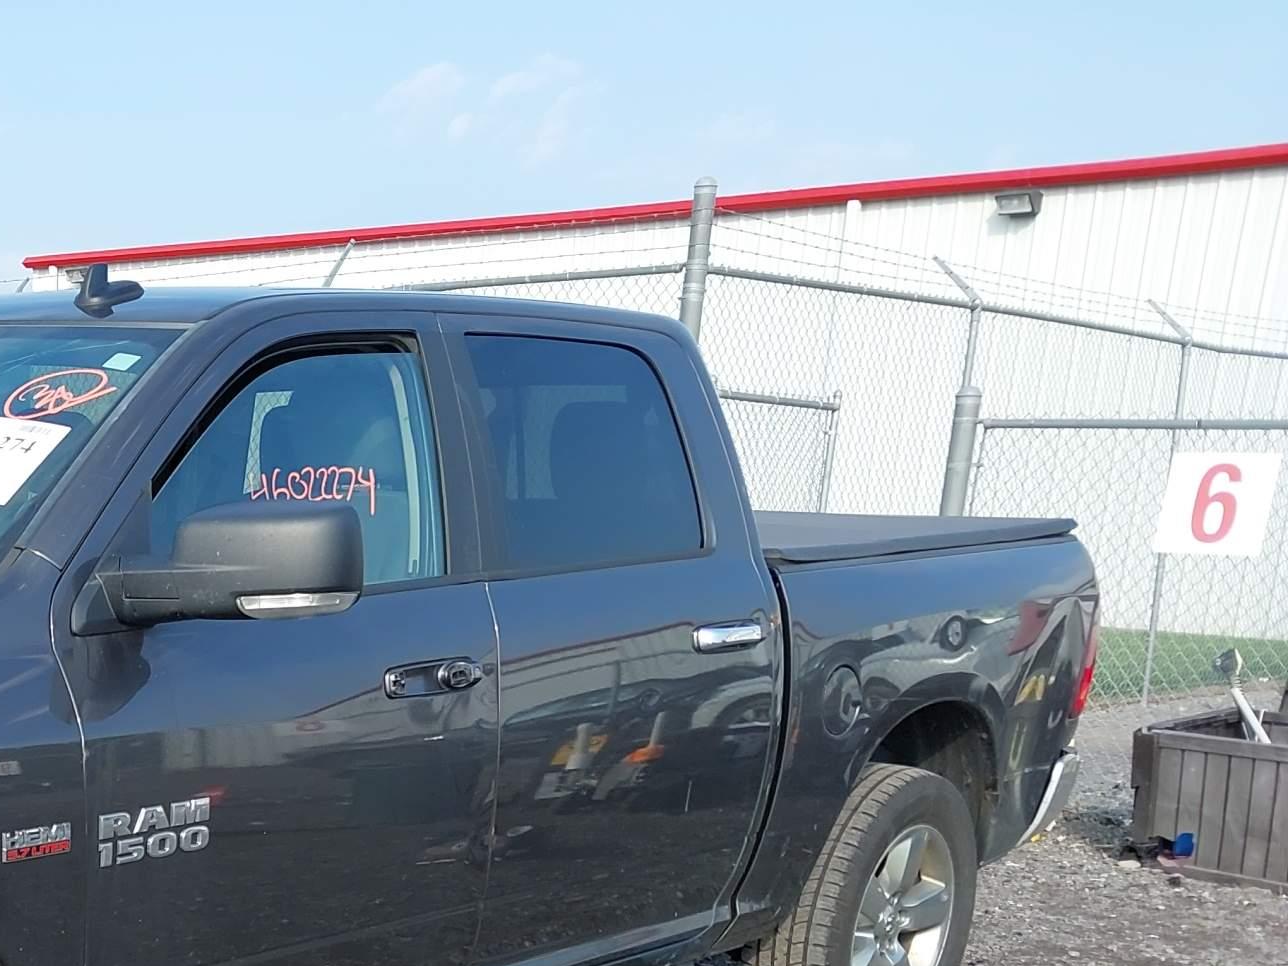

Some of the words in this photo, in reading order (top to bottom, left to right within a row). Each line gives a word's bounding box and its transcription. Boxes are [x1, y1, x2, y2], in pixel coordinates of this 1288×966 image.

[250, 466, 376, 516] 46022274
[1189, 463, 1242, 543] 6
[2, 822, 71, 849] HEMI
[98, 796, 211, 841] RAM
[98, 825, 210, 868] 1500
